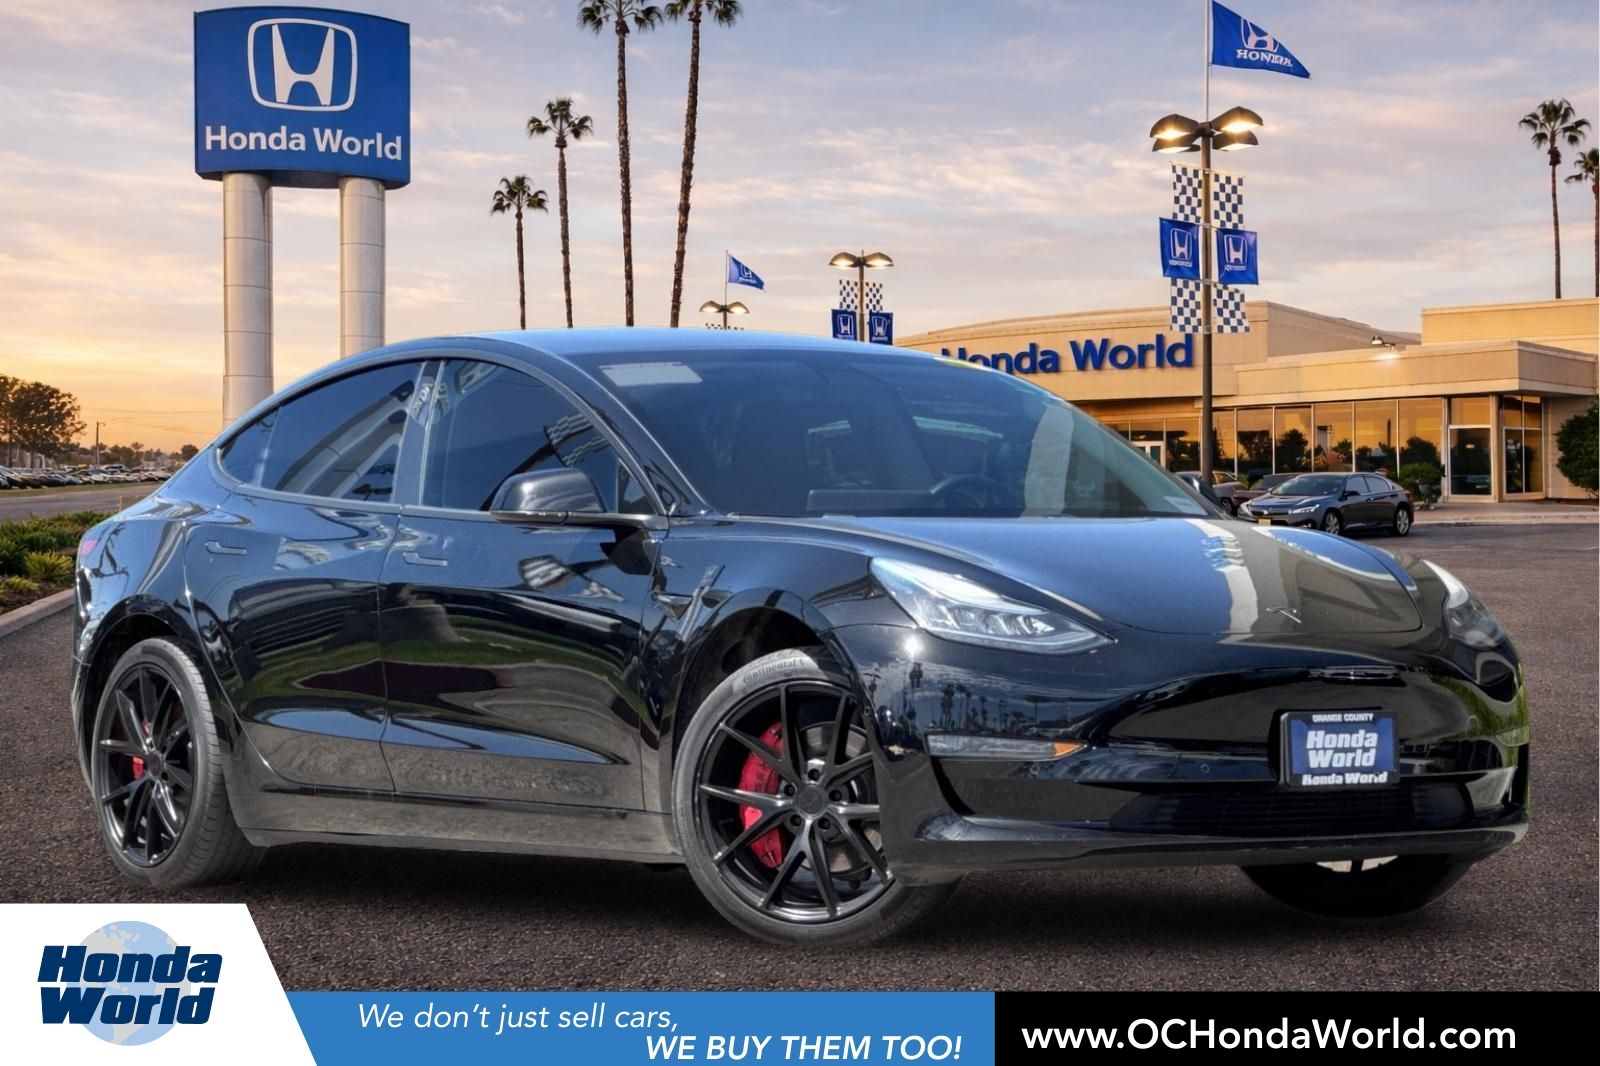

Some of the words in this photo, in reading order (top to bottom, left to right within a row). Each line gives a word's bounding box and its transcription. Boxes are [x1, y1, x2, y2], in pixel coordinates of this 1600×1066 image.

[205, 125, 306, 151] Honda
[313, 128, 402, 161] World
[1070, 333, 1193, 371] World
[1343, 713, 1374, 722] COUNTY
[1306, 729, 1378, 749] Honda
[1308, 748, 1377, 768] World
[1301, 772, 1344, 786] Honda
[1344, 770, 1389, 785] World
